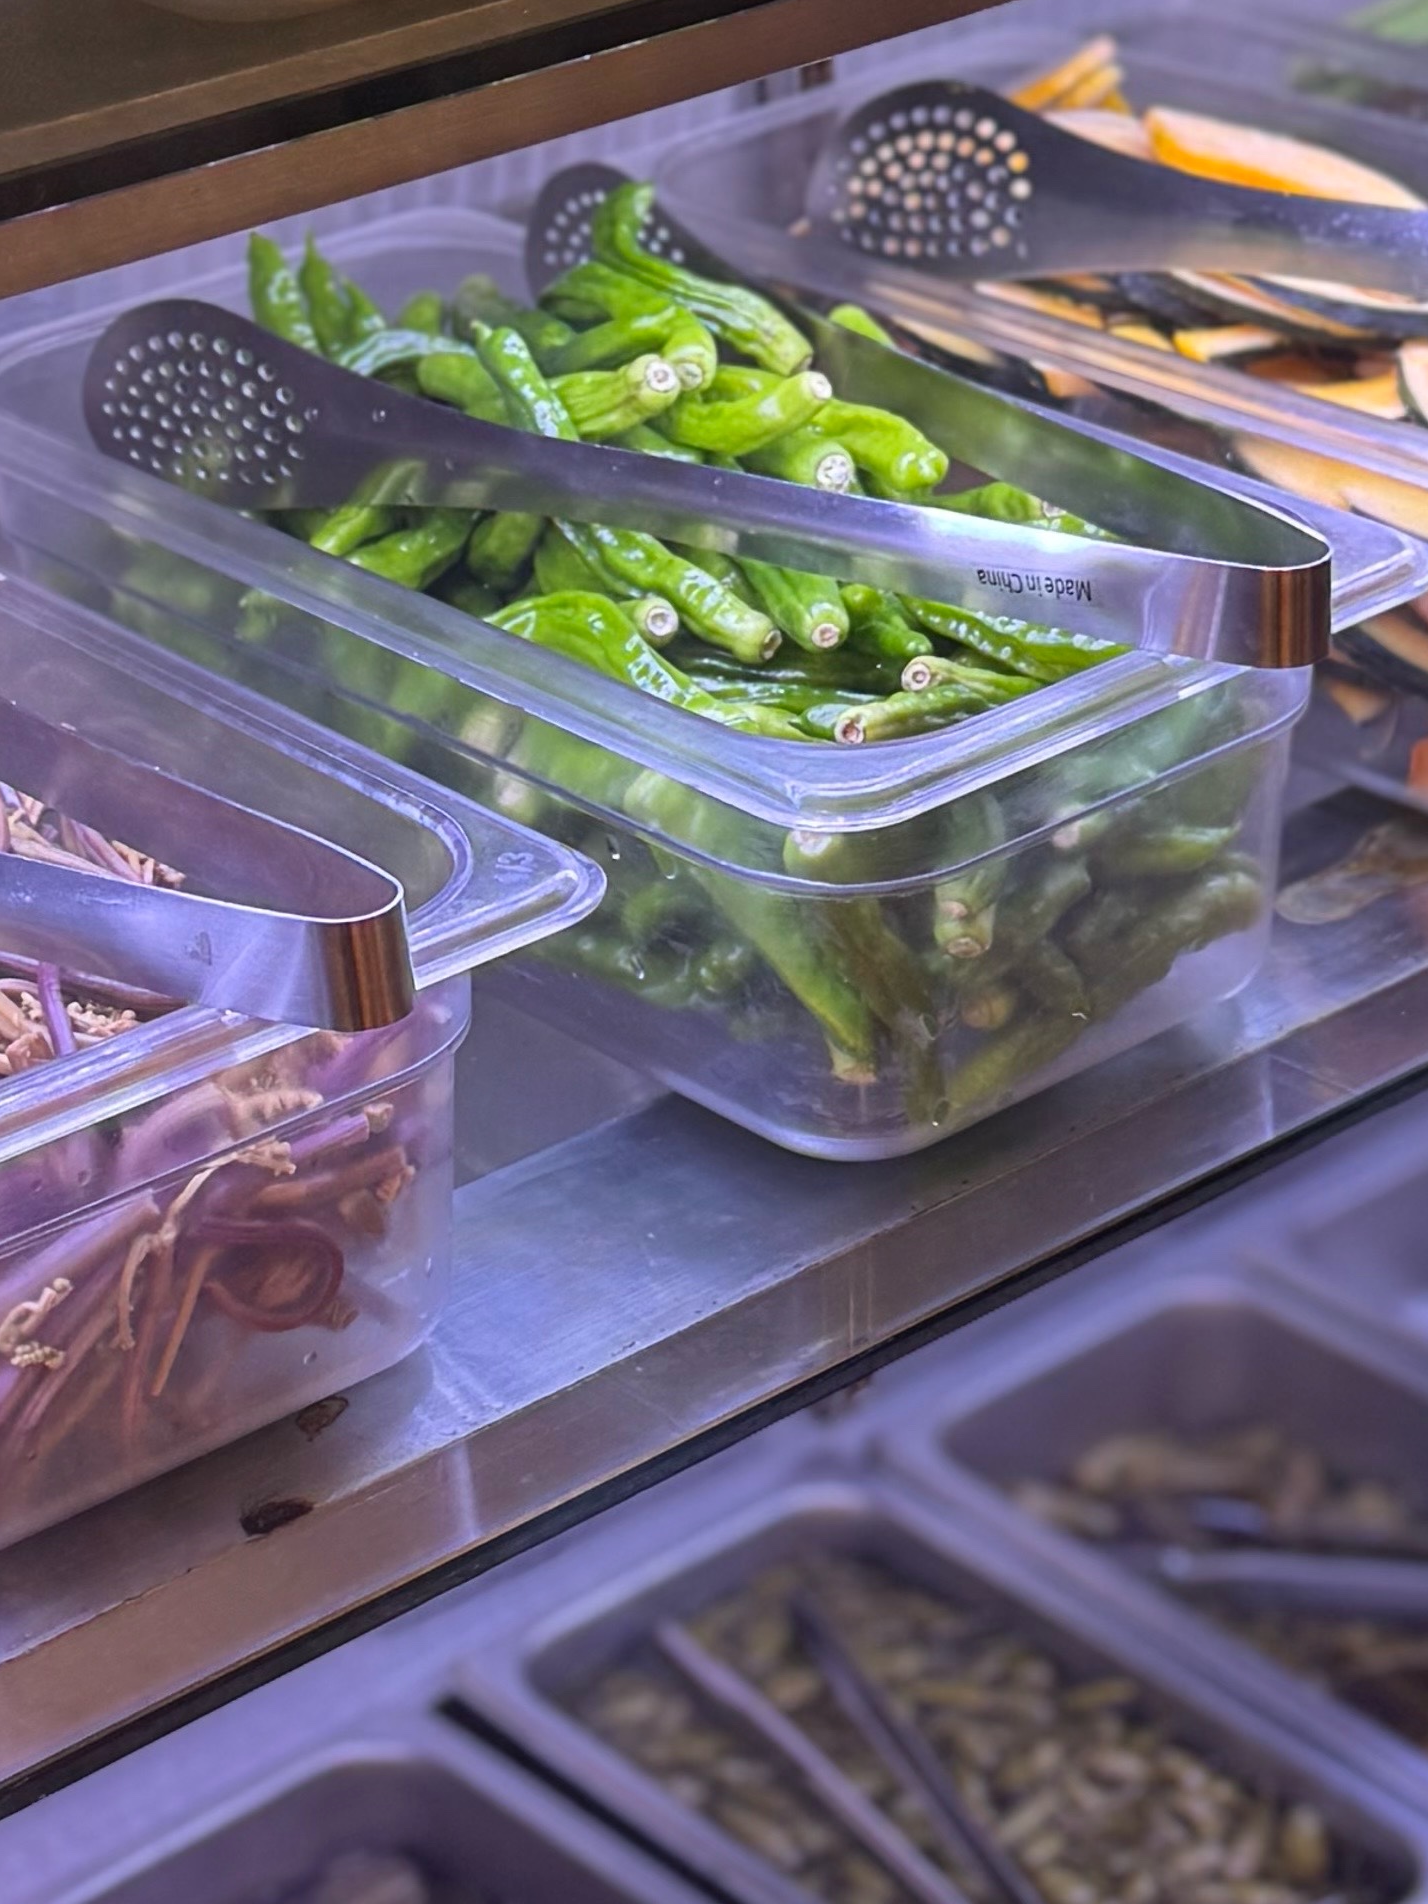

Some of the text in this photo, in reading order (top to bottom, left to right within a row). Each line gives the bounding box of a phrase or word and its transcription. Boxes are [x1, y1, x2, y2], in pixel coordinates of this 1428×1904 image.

[977, 569, 1092, 601] Made in China
